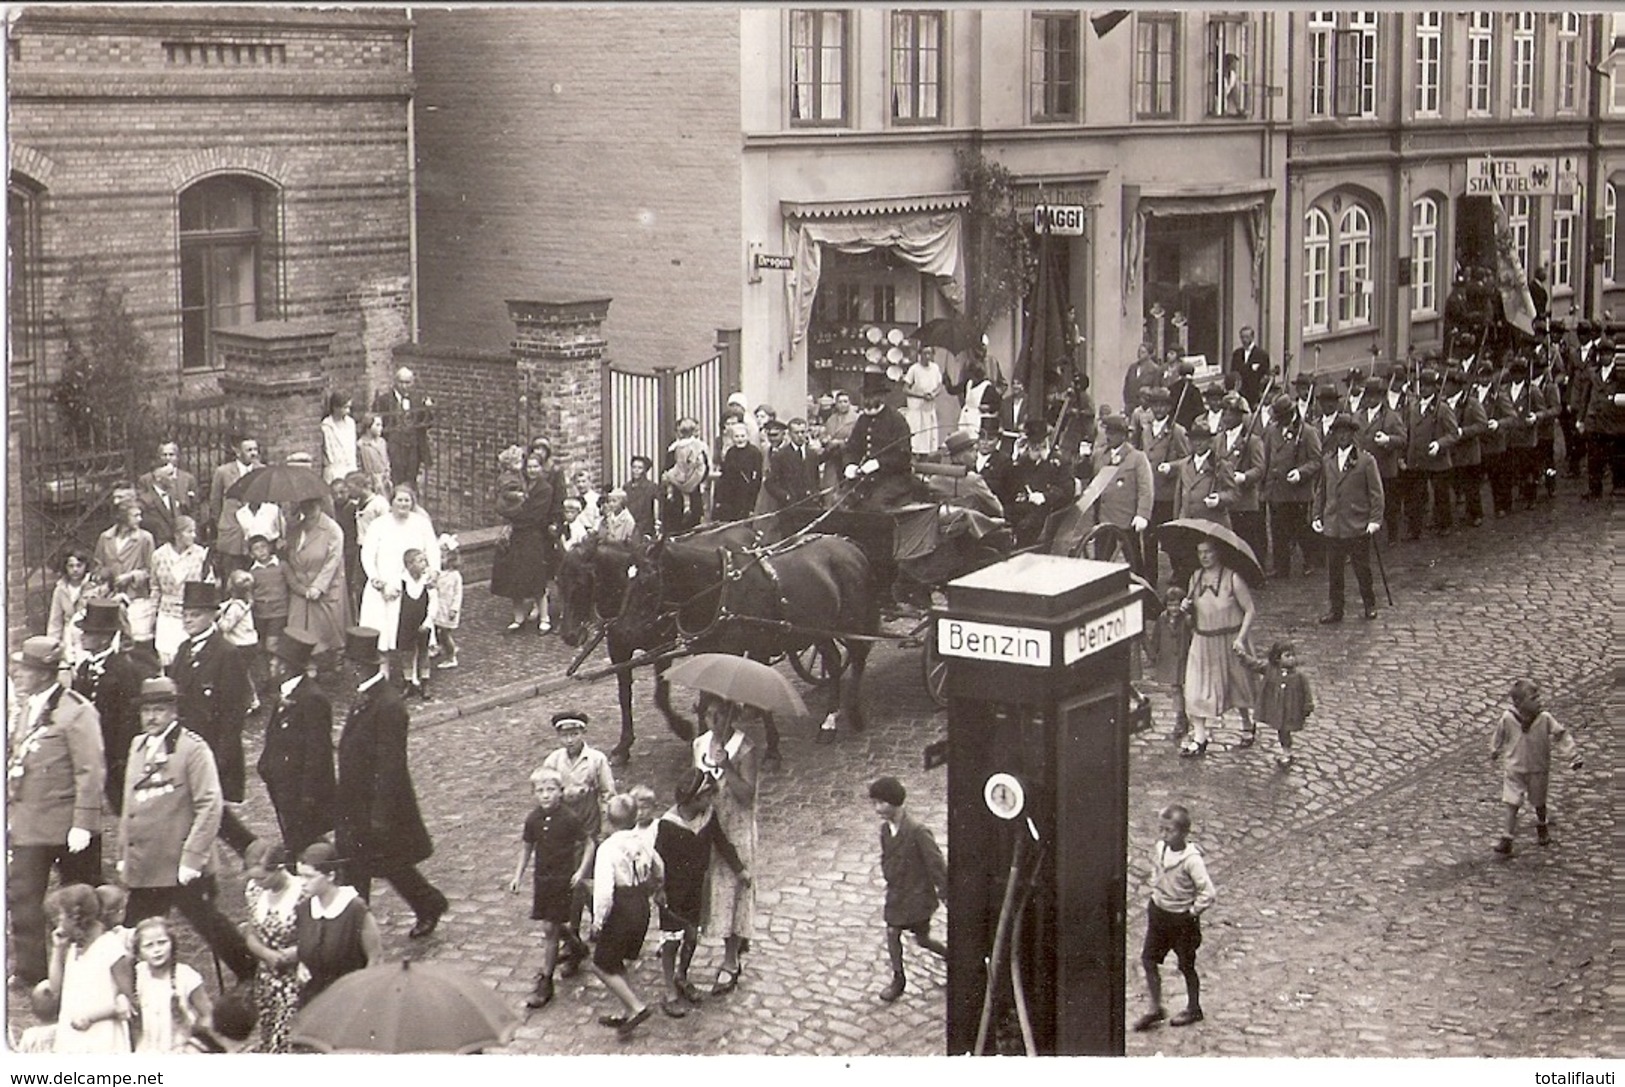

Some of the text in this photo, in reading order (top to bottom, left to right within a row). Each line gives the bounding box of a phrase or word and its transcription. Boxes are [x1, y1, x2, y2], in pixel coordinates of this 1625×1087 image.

[1506, 177, 1531, 192] KIEL
[758, 255, 791, 269] Drogen
[950, 623, 1040, 659] Benzin
[1077, 609, 1127, 653] Benzol
